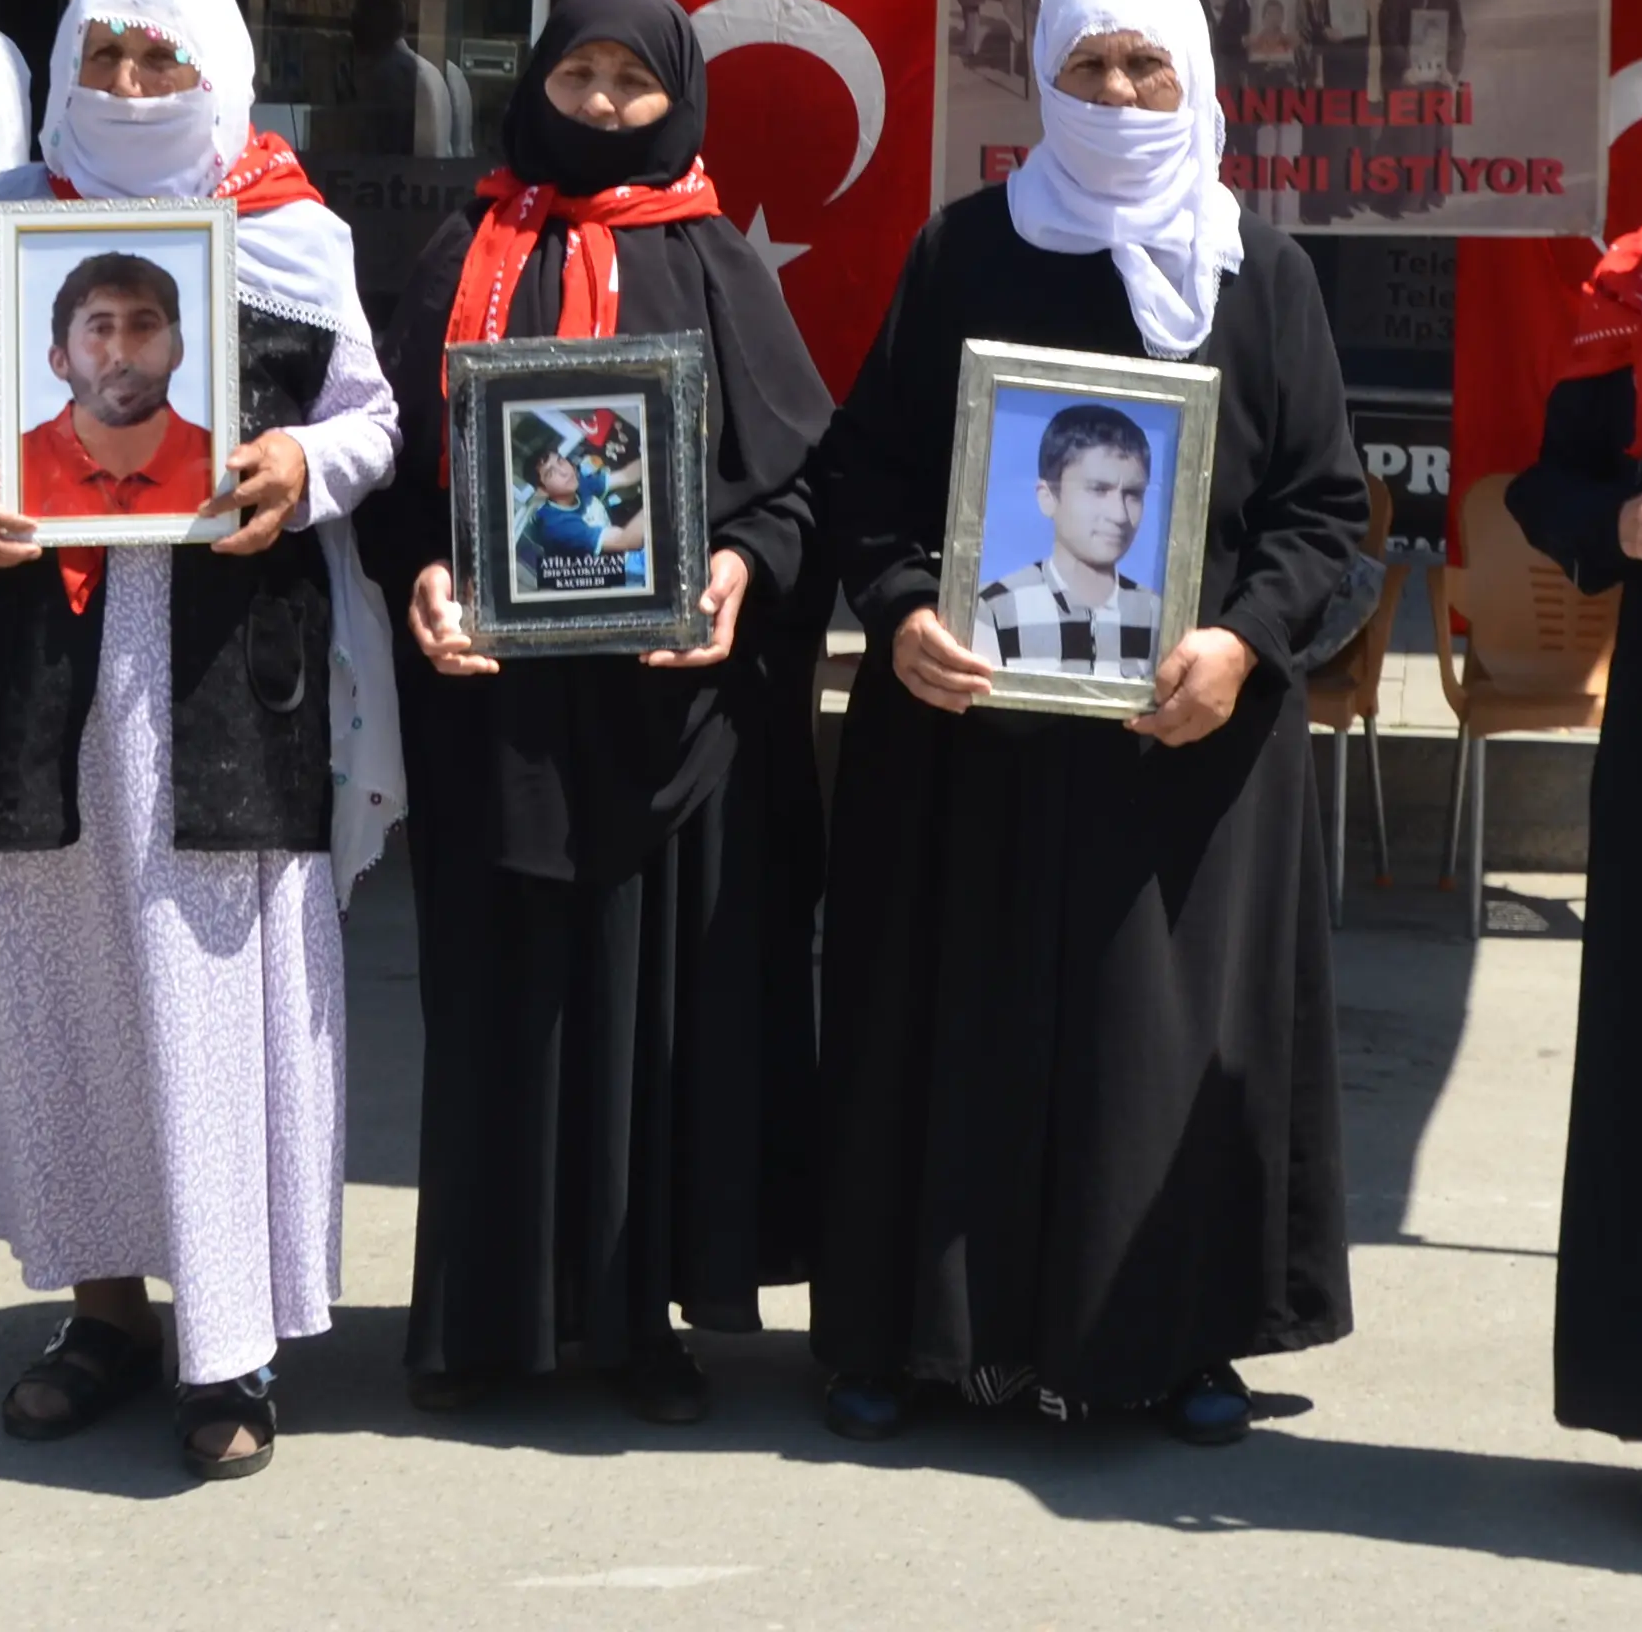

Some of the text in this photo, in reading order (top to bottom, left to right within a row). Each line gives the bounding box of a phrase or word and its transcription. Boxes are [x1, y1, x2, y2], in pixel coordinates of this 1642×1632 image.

[1349, 144, 1567, 196] İSTİYOR
[325, 171, 470, 214] Fatur
[584, 553, 625, 568] ÖZCAN
